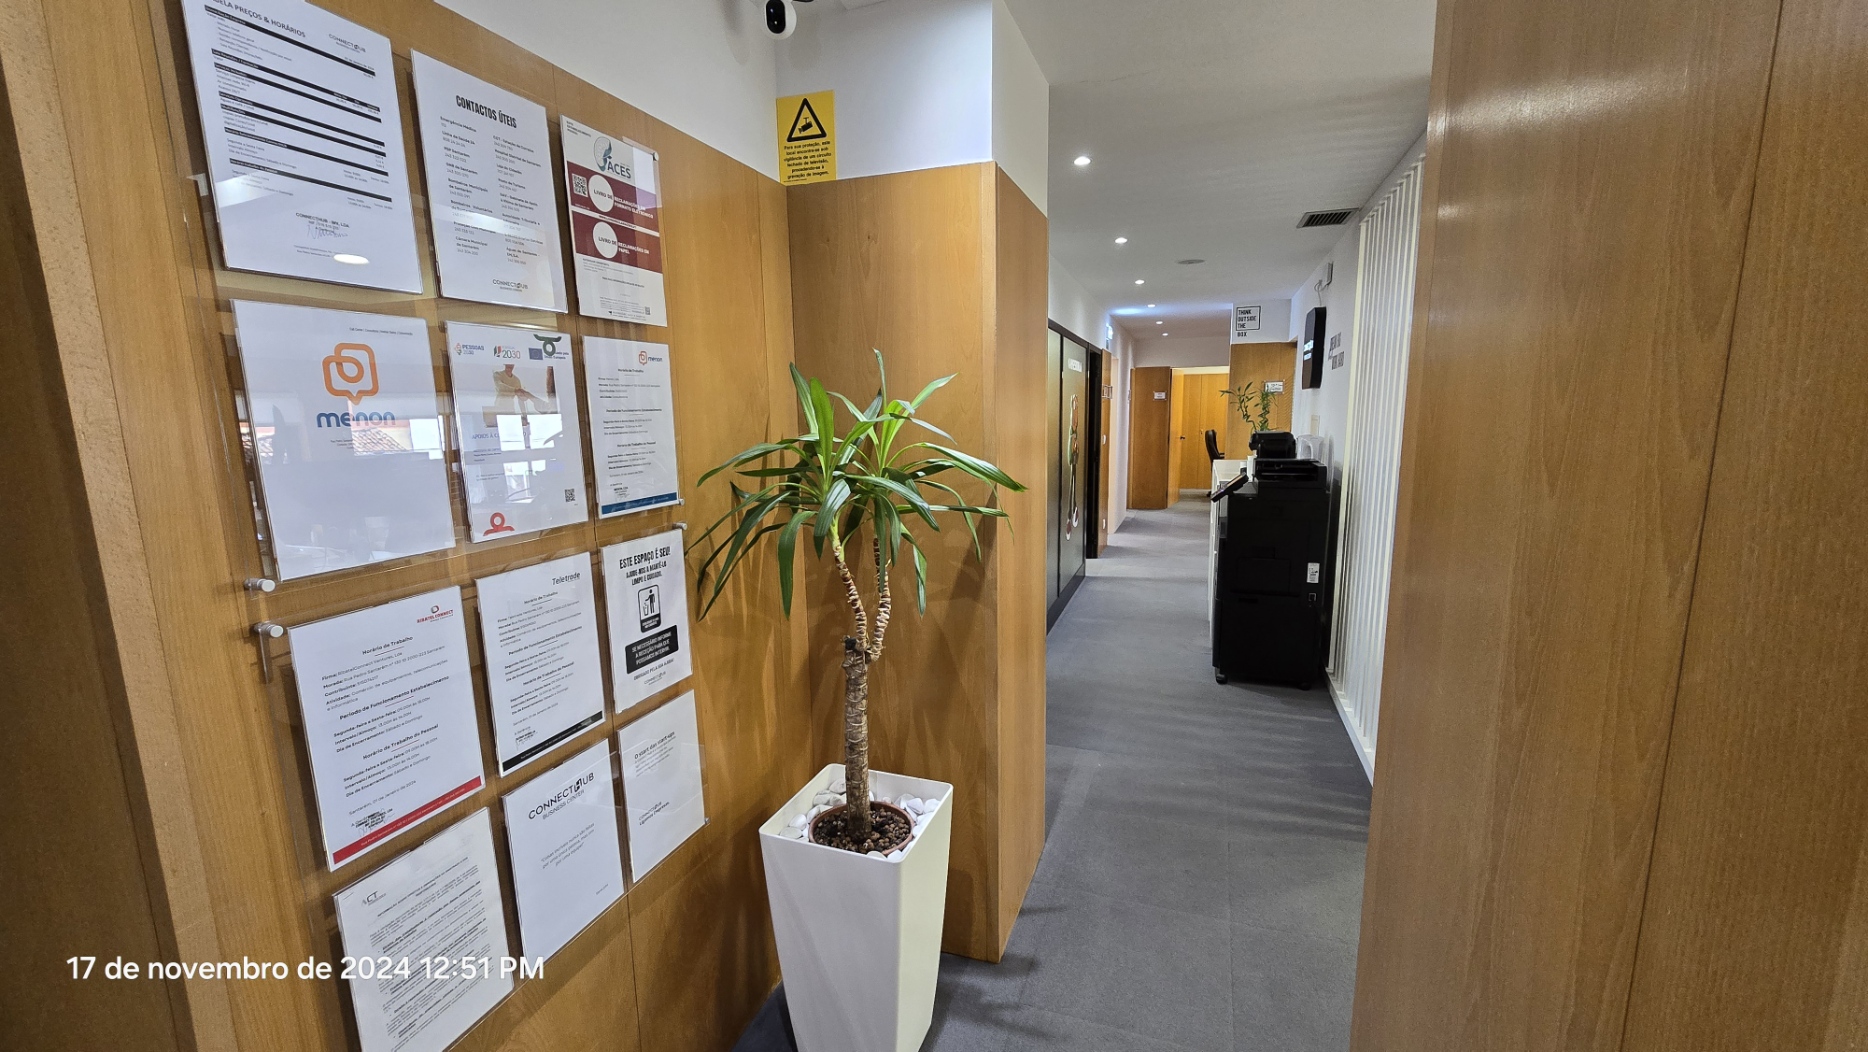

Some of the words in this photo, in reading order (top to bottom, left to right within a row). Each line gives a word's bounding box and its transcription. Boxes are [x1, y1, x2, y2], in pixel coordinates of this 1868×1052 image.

[233, 2, 262, 21] PREÇOS
[455, 94, 497, 121] CONTACTOS
[498, 109, 516, 128] ÚTEIS
[606, 159, 631, 179] ACES
[593, 188, 606, 197] LIVRO
[598, 236, 611, 244] LIVRO
[502, 349, 521, 359] 2030
[317, 411, 396, 428] menon
[619, 556, 632, 569] ESTE
[633, 550, 654, 566] ESPAÇO
[659, 545, 670, 557] SEU!
[551, 571, 580, 585] Teletrade
[361, 644, 382, 655] Horário
[390, 635, 413, 646] Trabalho
[339, 708, 361, 720] Período
[370, 690, 409, 708] Funcionamento
[410, 675, 449, 693] Estabelecimento
[362, 747, 383, 760] Horário
[390, 734, 413, 747] Trabalho
[420, 723, 438, 735] Pessoal
[527, 771, 594, 820] CONNECTHUB
[542, 800, 566, 820] BUSINESS
[566, 788, 584, 804] CENTER
